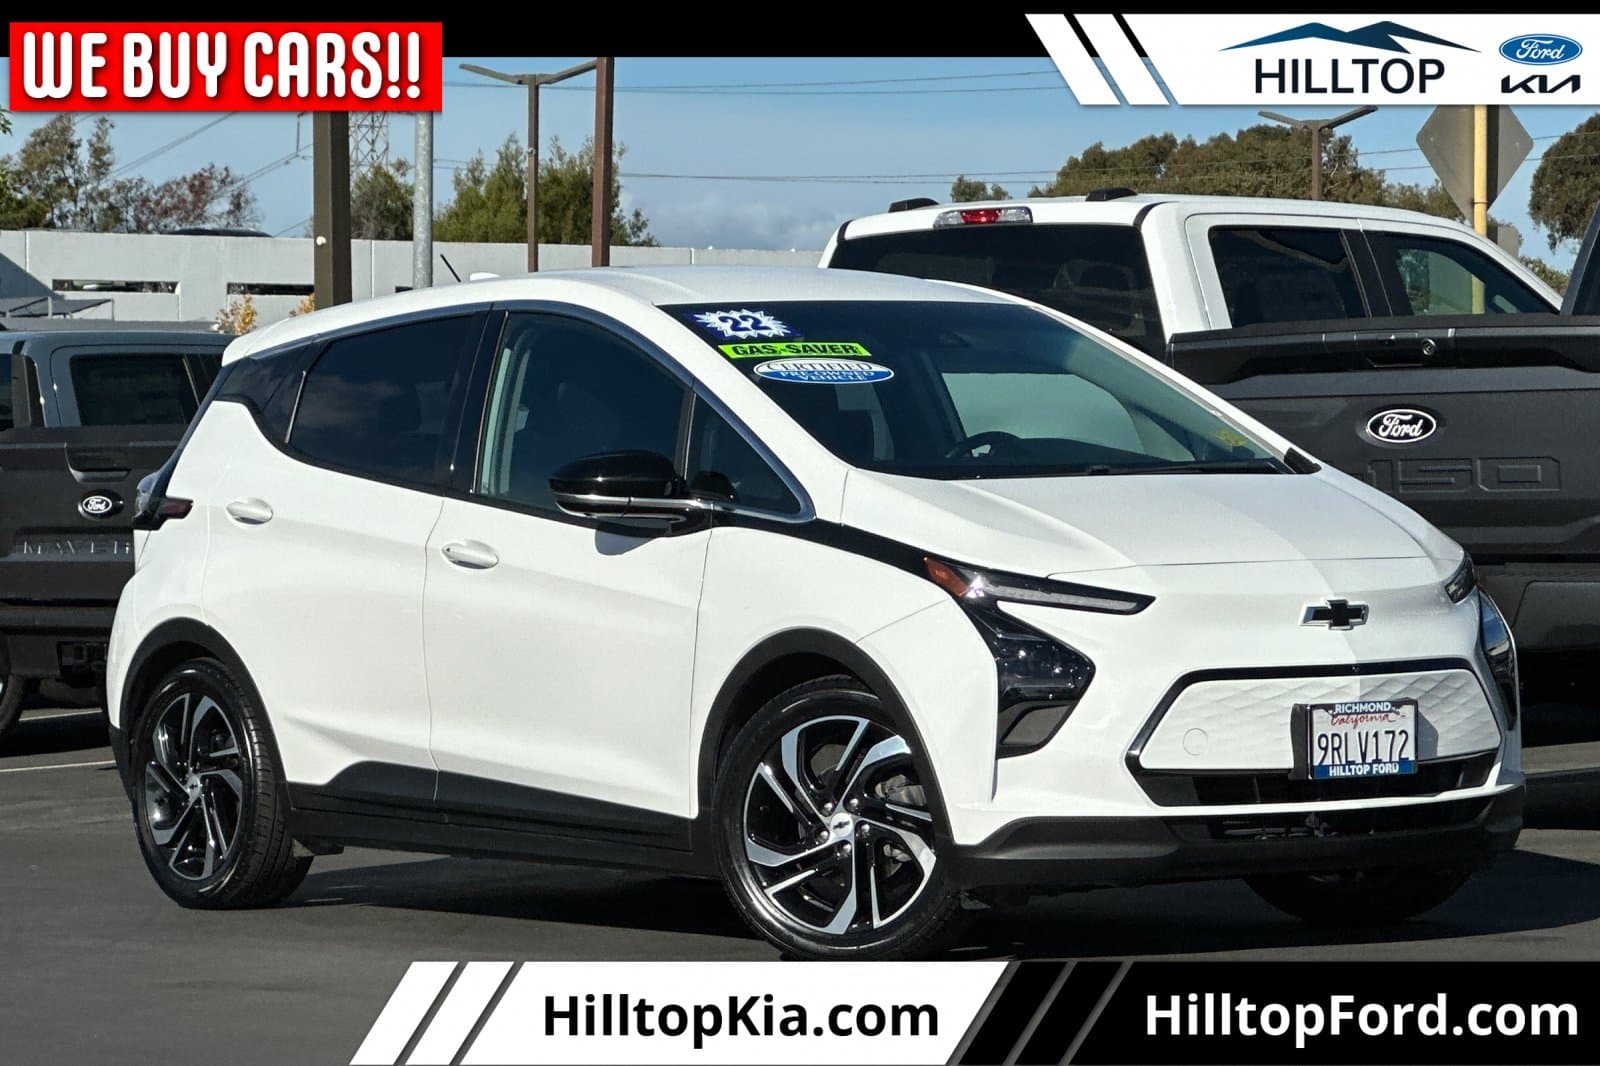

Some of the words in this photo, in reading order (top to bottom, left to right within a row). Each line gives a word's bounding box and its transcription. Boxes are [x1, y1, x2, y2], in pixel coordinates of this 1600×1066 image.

[718, 315, 771, 332] 22
[1378, 412, 1423, 438] Ford
[87, 498, 107, 511] Ford
[1334, 702, 1392, 714] RICHMOND
[1330, 713, 1393, 729] California
[1317, 729, 1409, 766] 9RLV172
[1329, 764, 1370, 777] HILLTOP
[1372, 762, 1399, 775] FORD
